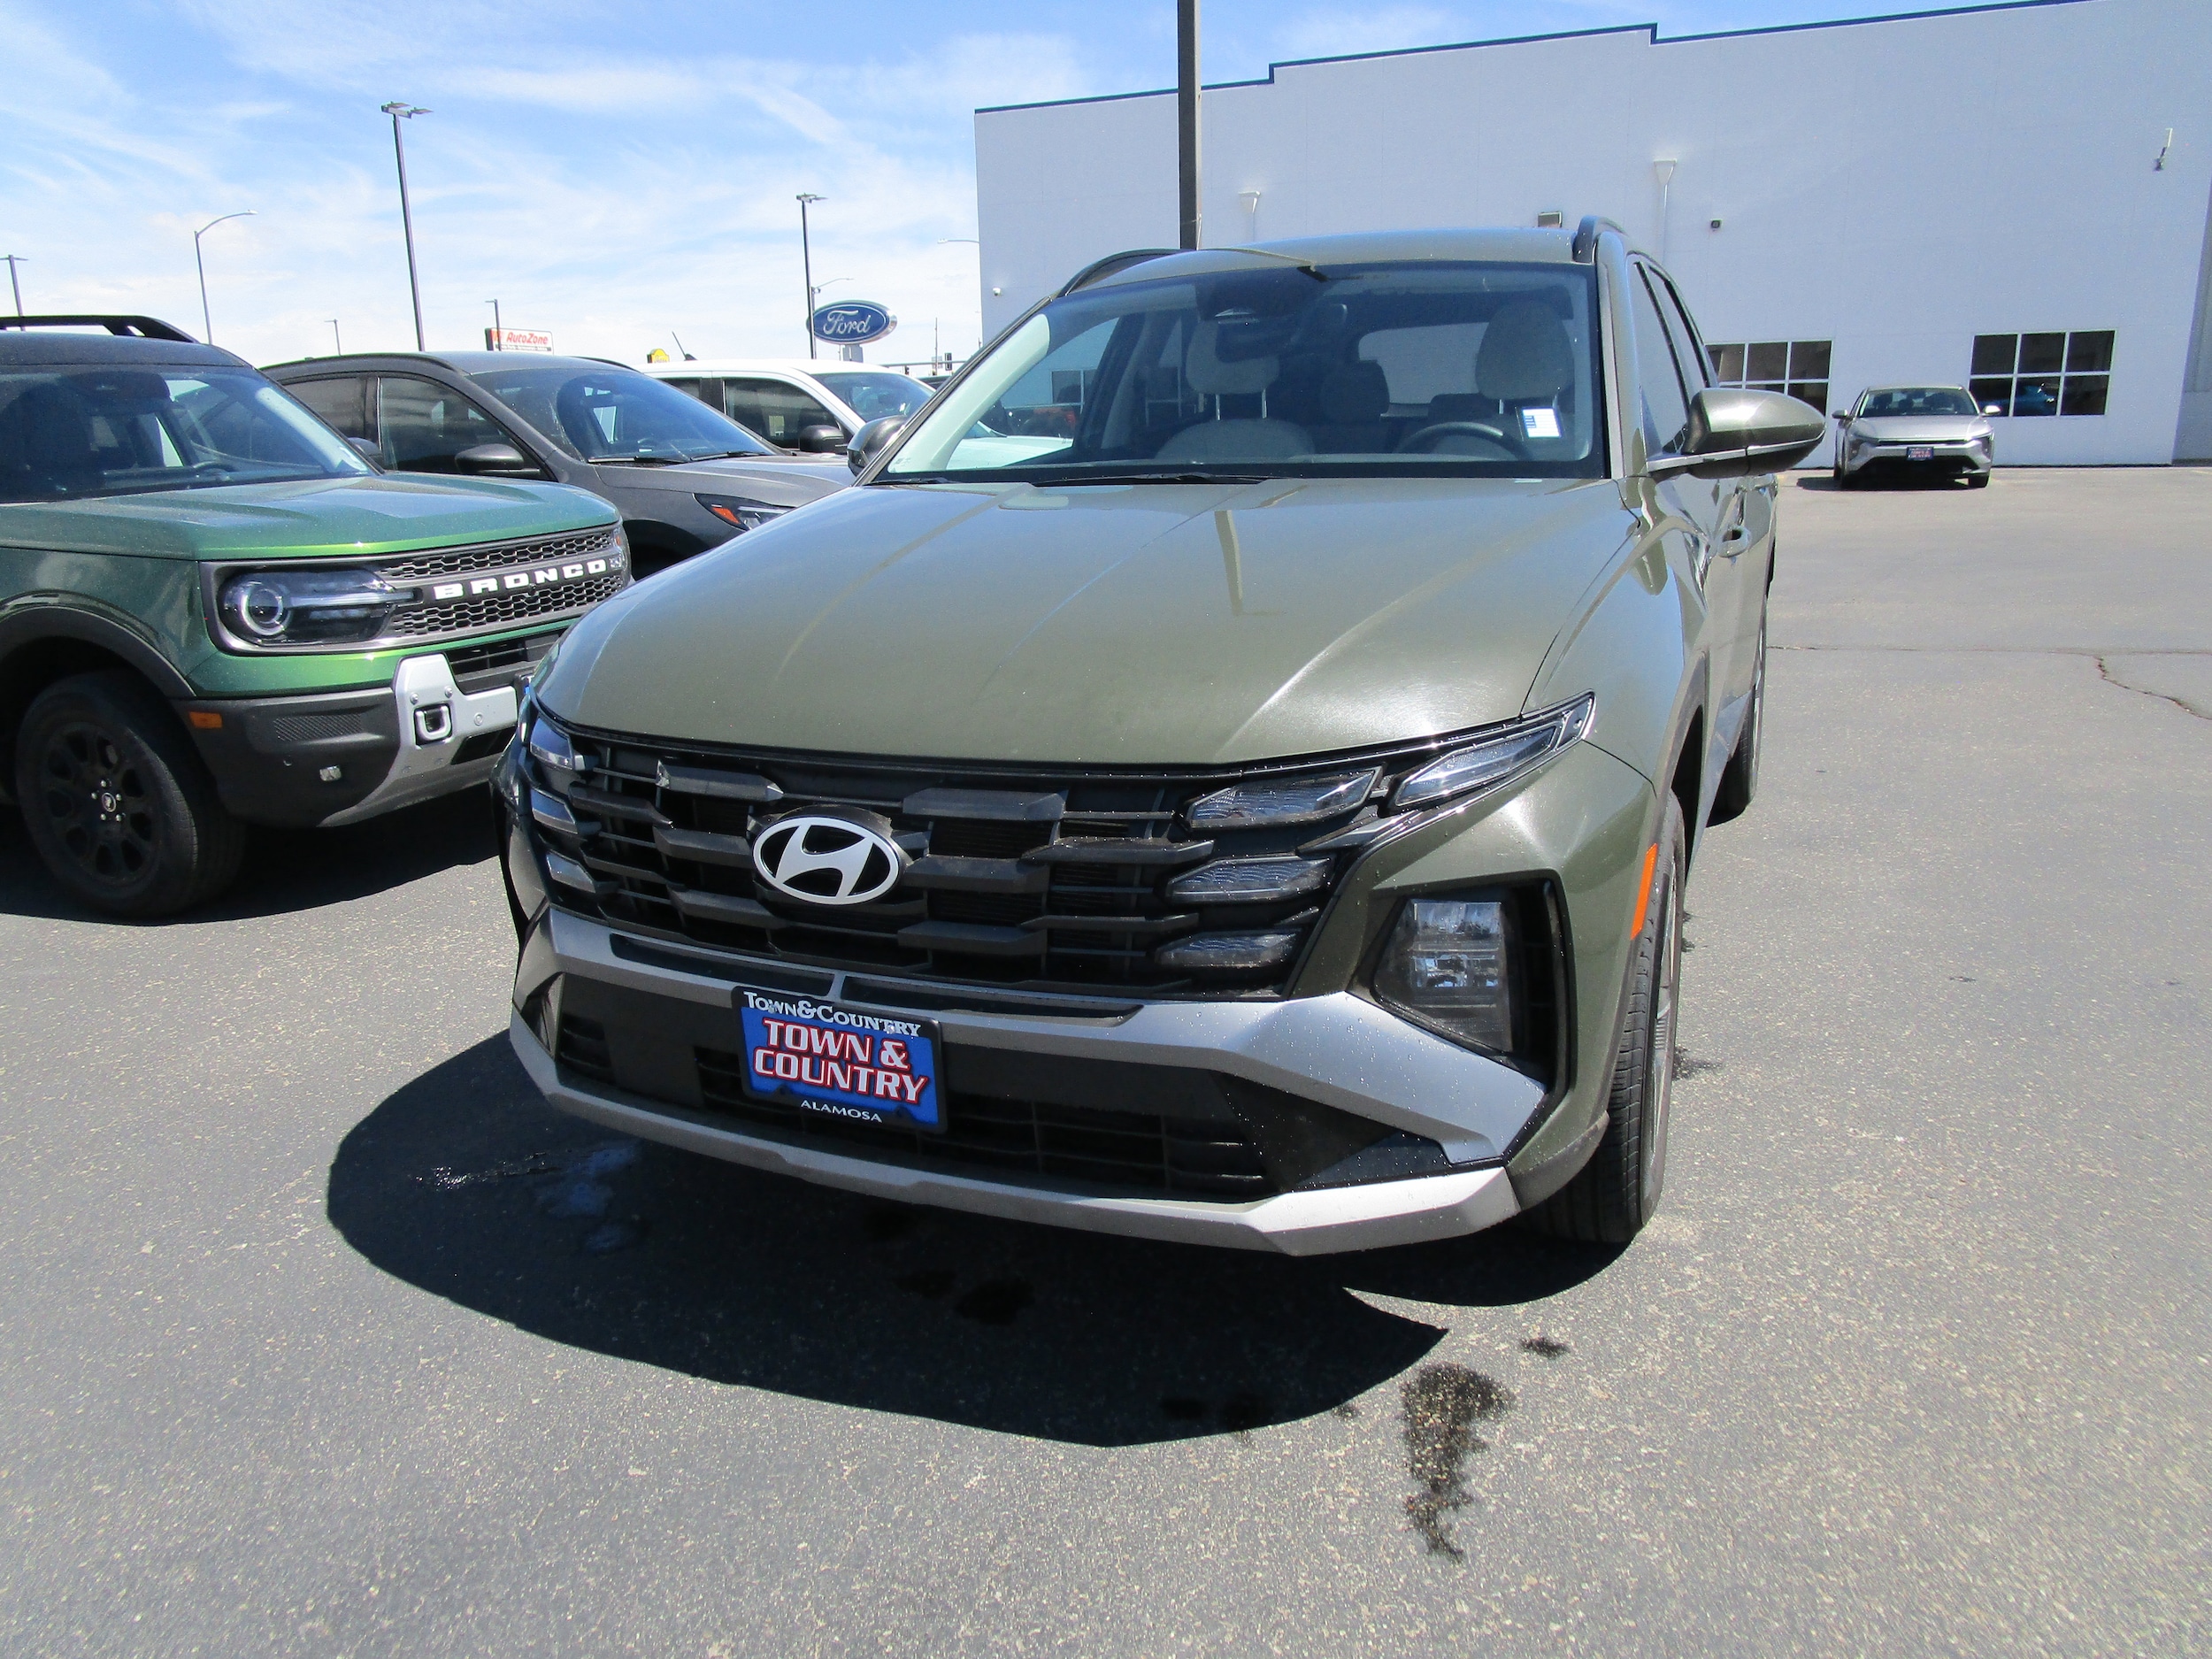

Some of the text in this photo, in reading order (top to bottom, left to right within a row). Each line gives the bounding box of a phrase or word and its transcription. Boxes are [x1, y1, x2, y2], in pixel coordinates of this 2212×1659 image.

[506, 332, 549, 344] AutoZone
[824, 310, 871, 334] Ford
[434, 559, 607, 599] BRONCO
[763, 1017, 910, 1071] TOWN &
[754, 1046, 928, 1103] COUNTRY
[801, 1100, 883, 1124] ALAMOSA
